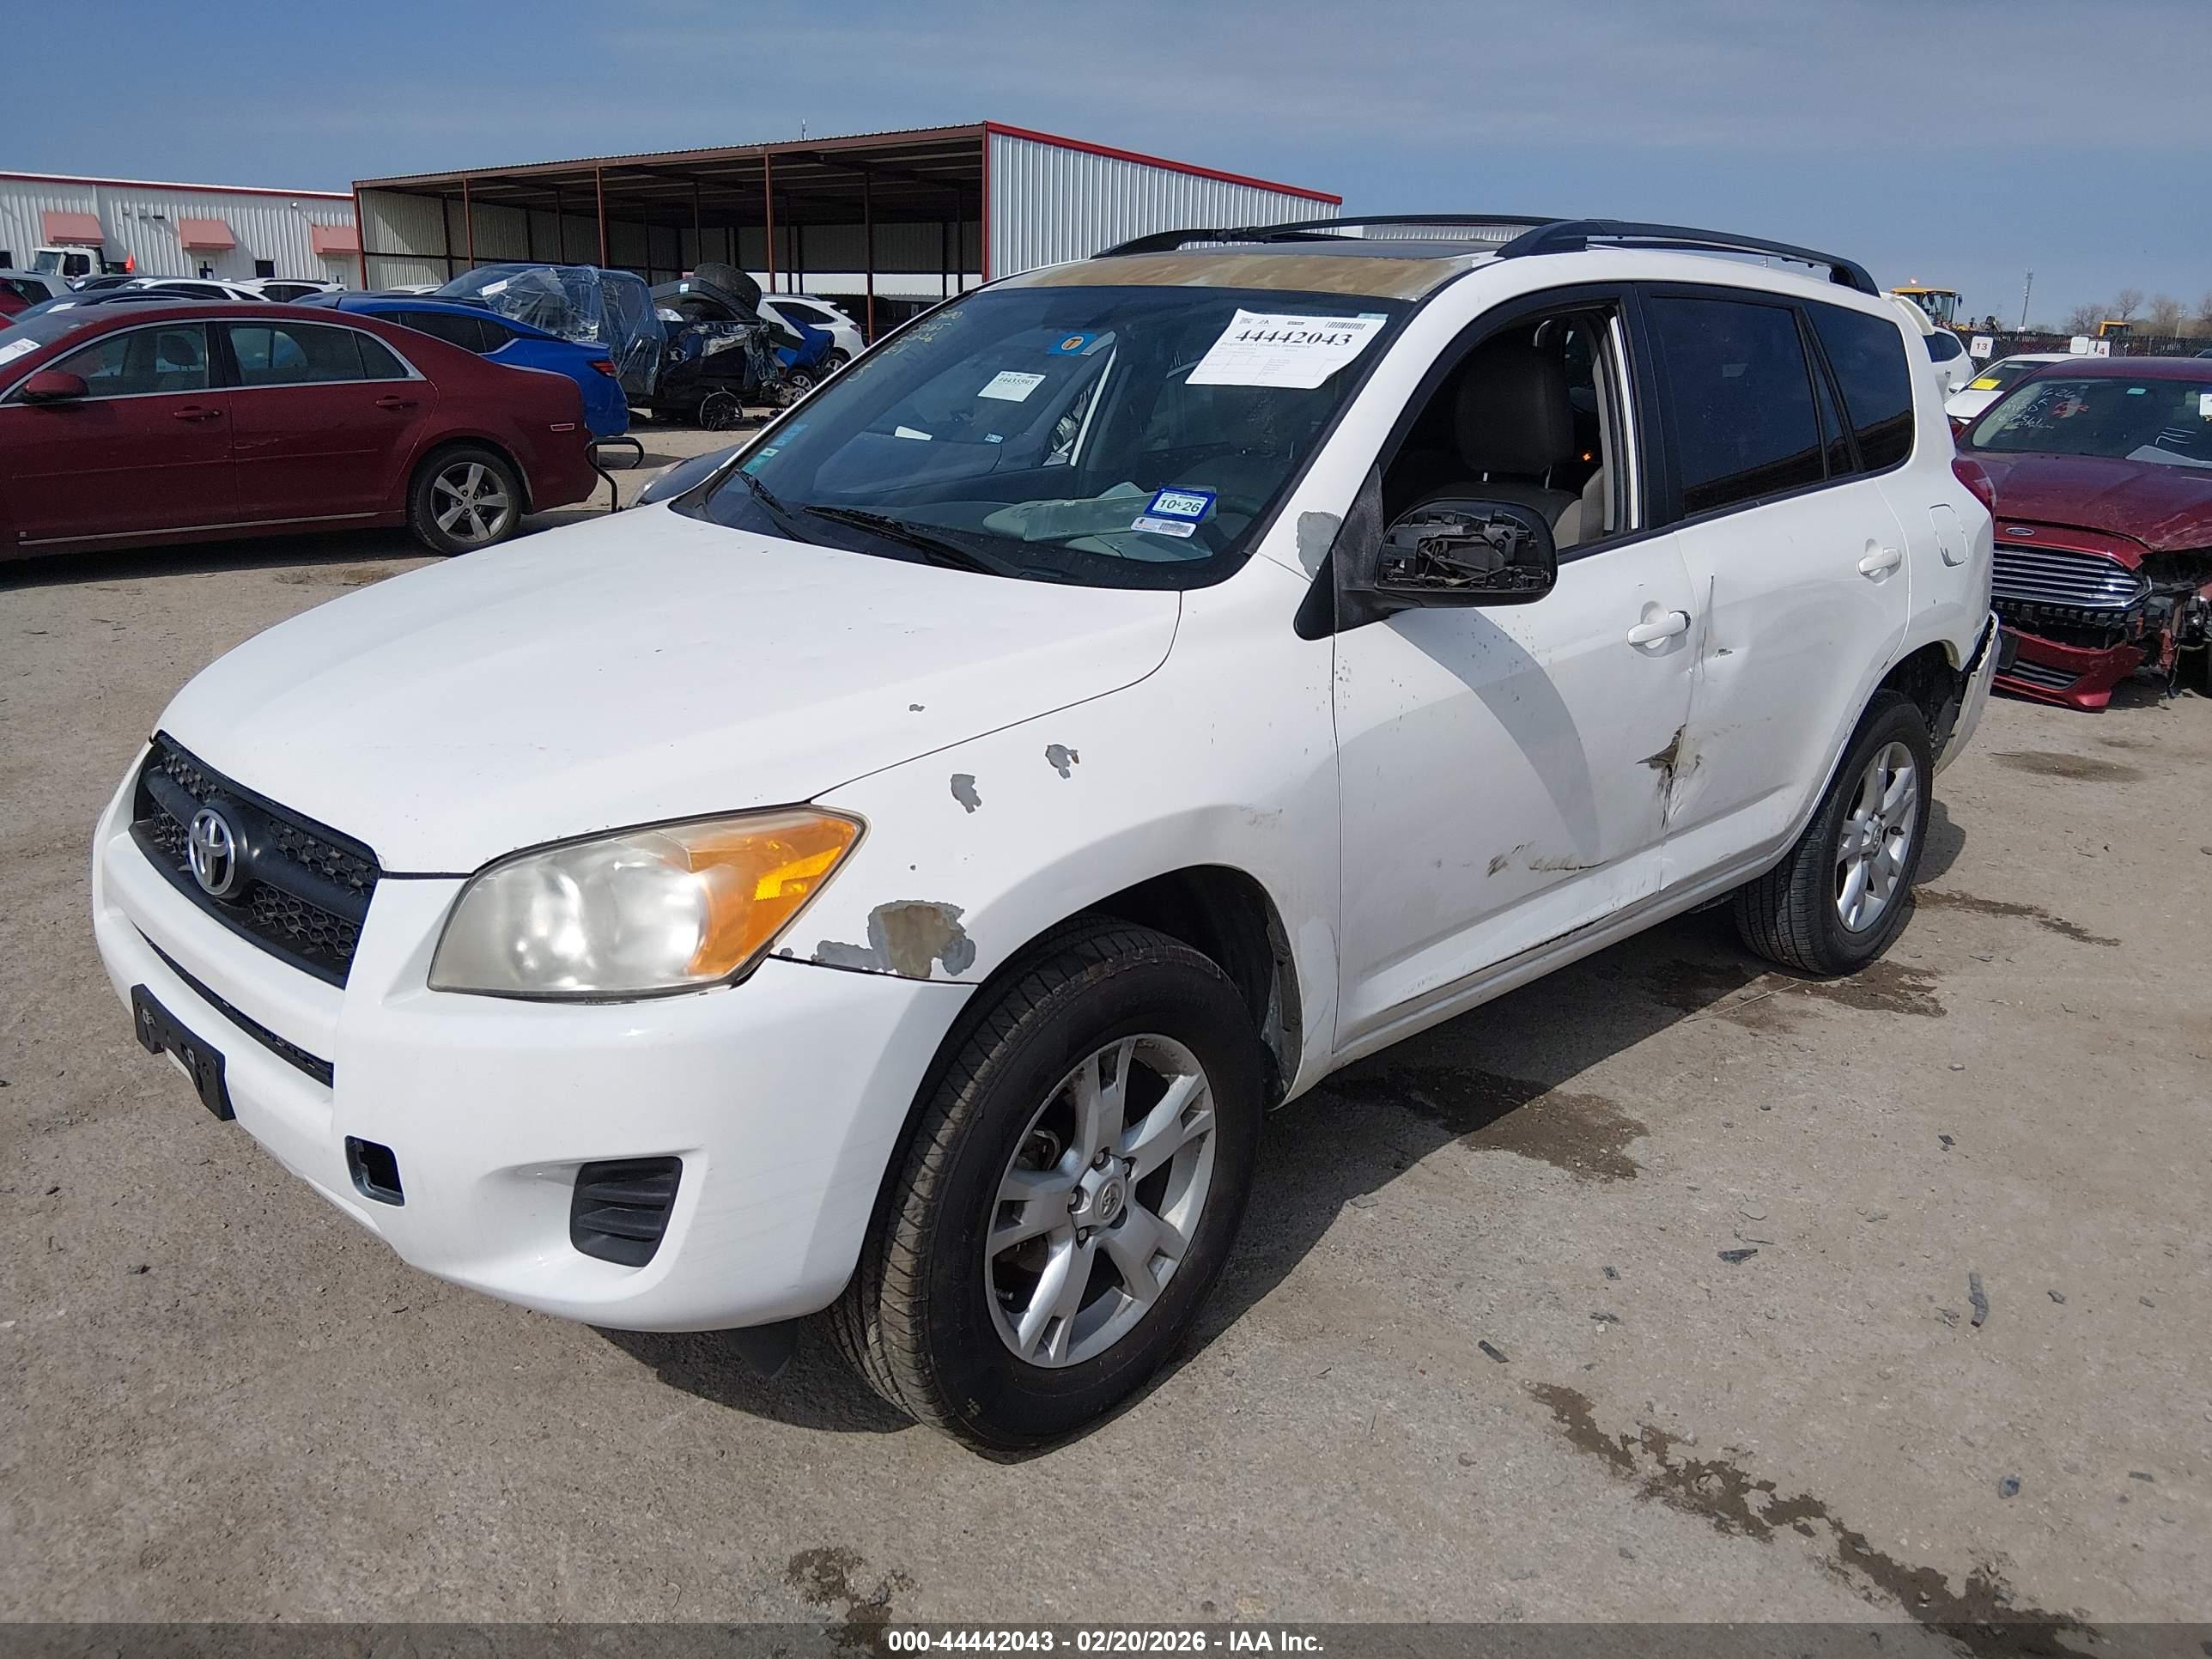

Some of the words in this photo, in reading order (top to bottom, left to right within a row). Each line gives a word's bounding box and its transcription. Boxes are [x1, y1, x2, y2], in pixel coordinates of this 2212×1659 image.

[1235, 329, 1352, 346] 44442043
[1976, 343, 1988, 351] 13
[1160, 499, 1177, 509] 10
[1182, 501, 1202, 513] 26
